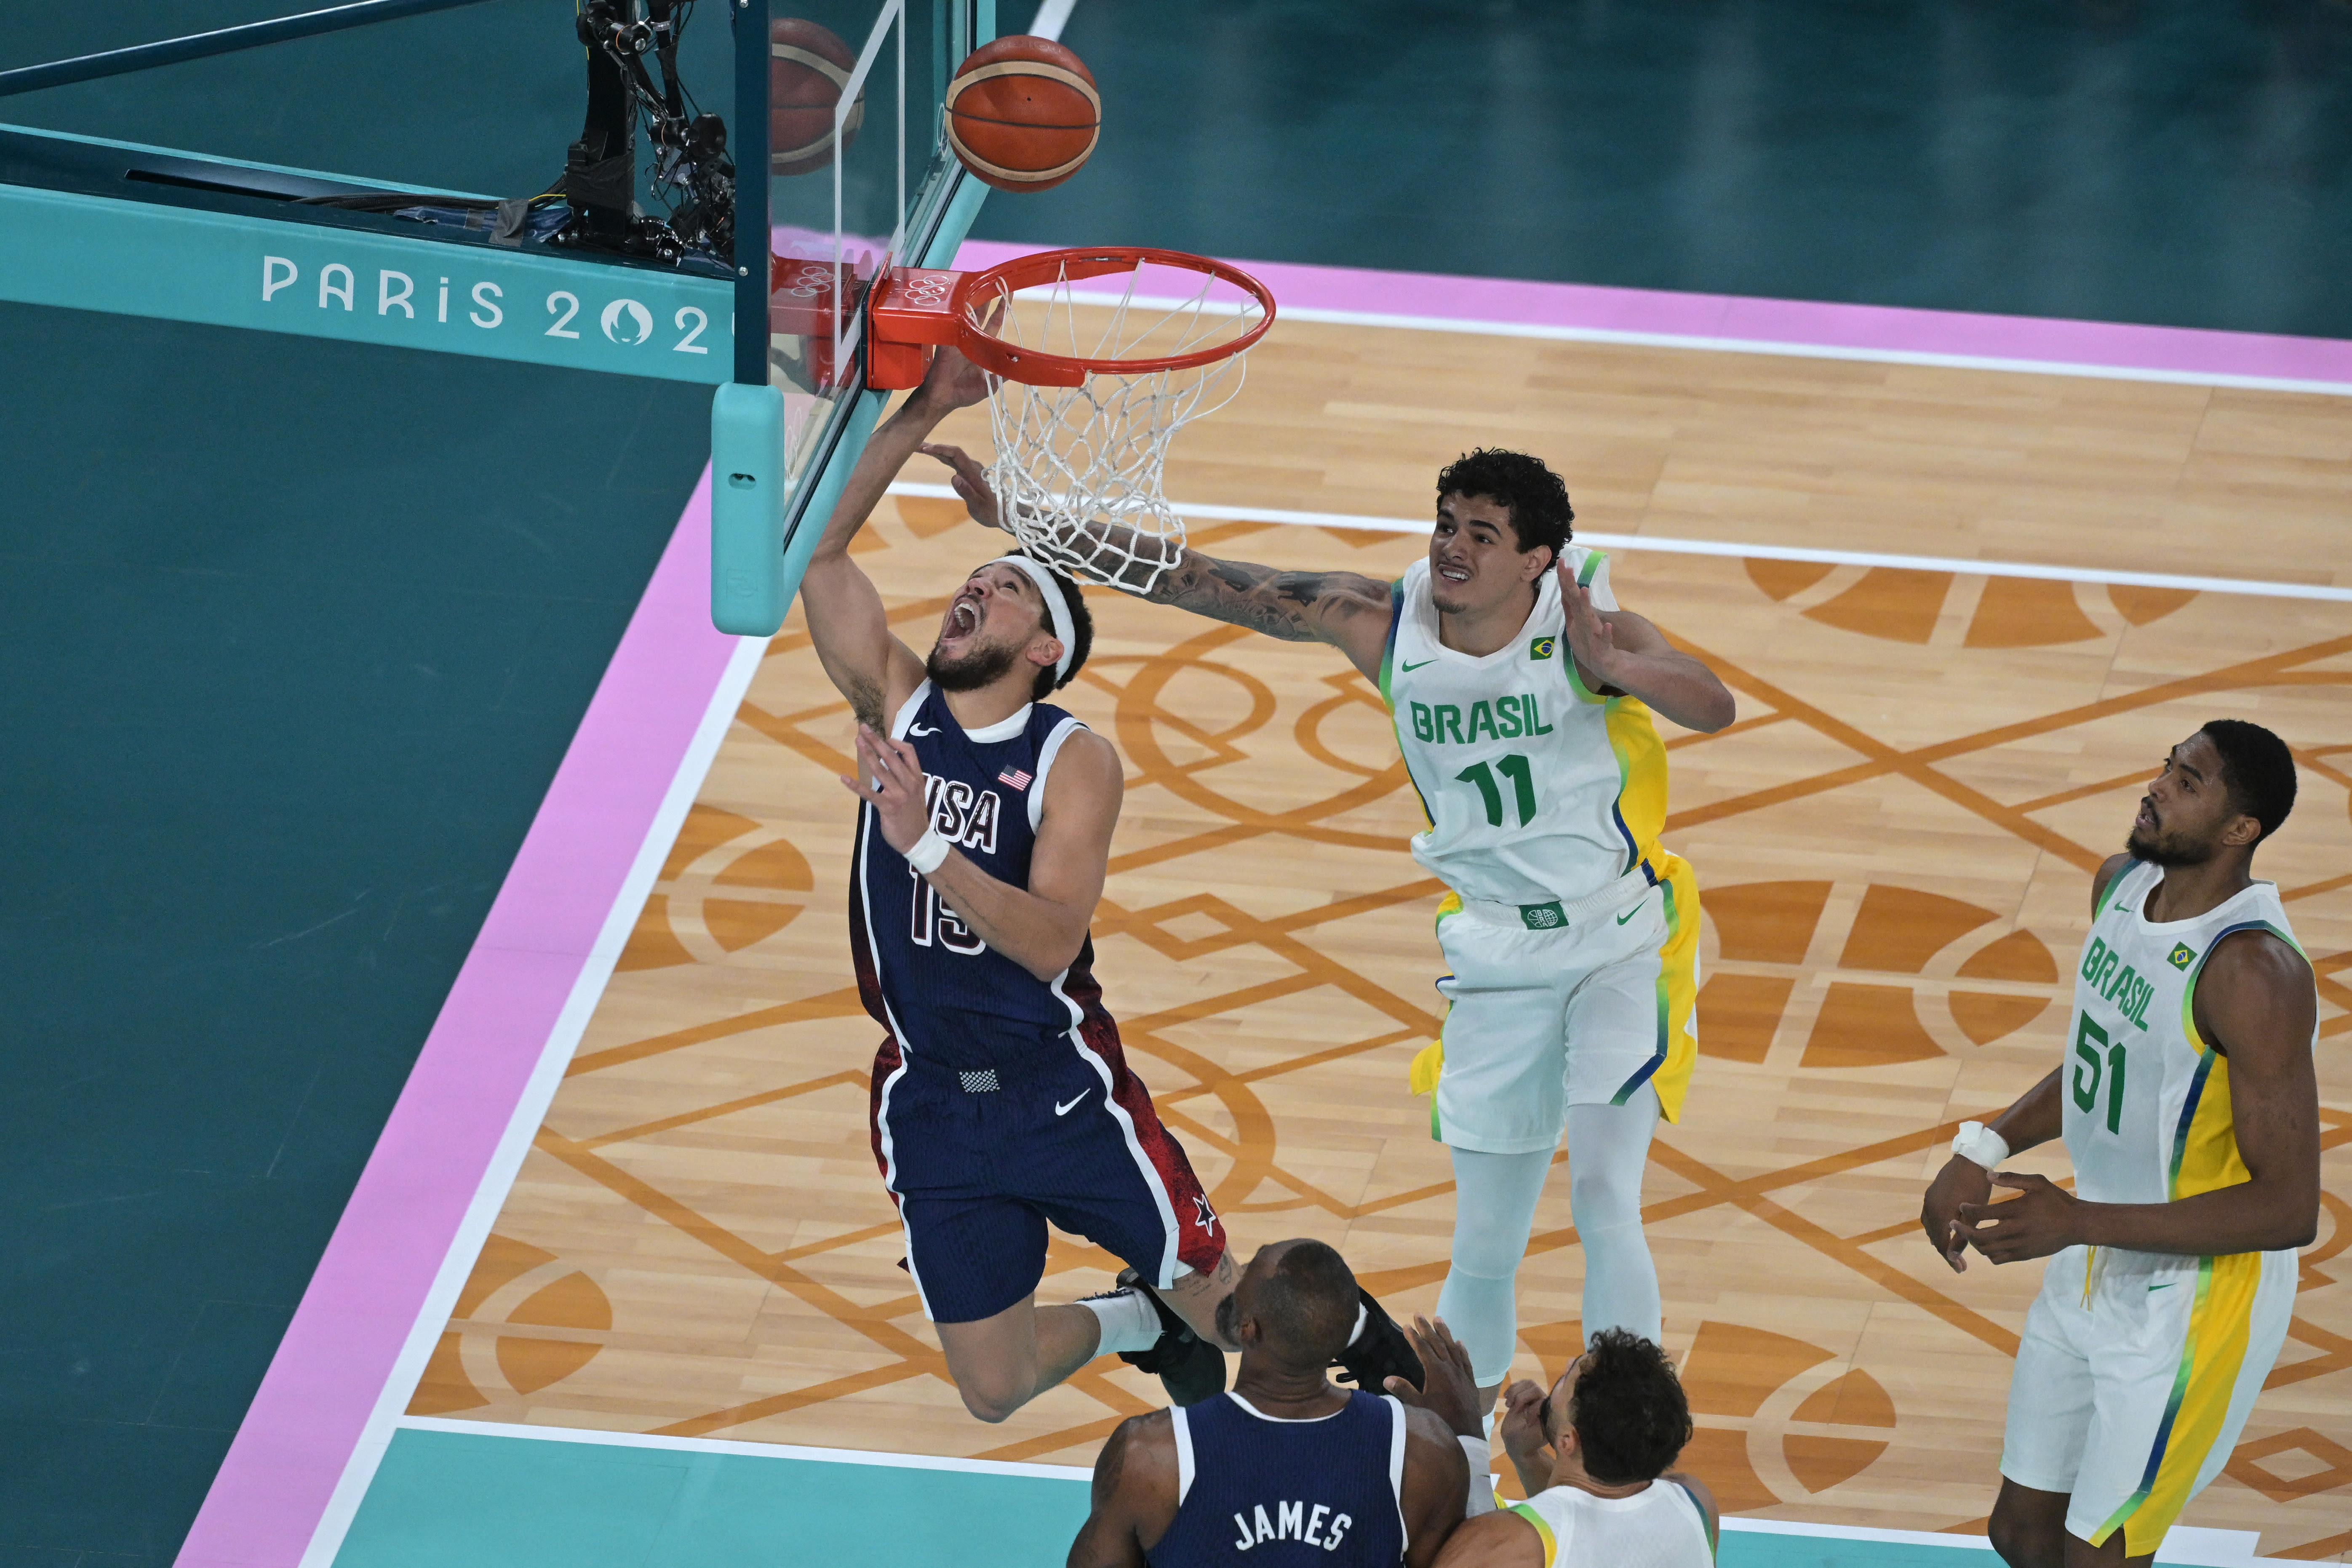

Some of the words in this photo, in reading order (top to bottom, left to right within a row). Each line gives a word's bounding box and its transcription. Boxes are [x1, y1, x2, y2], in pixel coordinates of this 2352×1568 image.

[545, 291, 734, 354] 202
[1410, 693, 1554, 744] BRASIL
[1455, 754, 1537, 828] 11
[2081, 936, 2155, 1032] BRASIL
[2072, 1009, 2127, 1135] 51
[1234, 1500, 1352, 1551] JAMES
